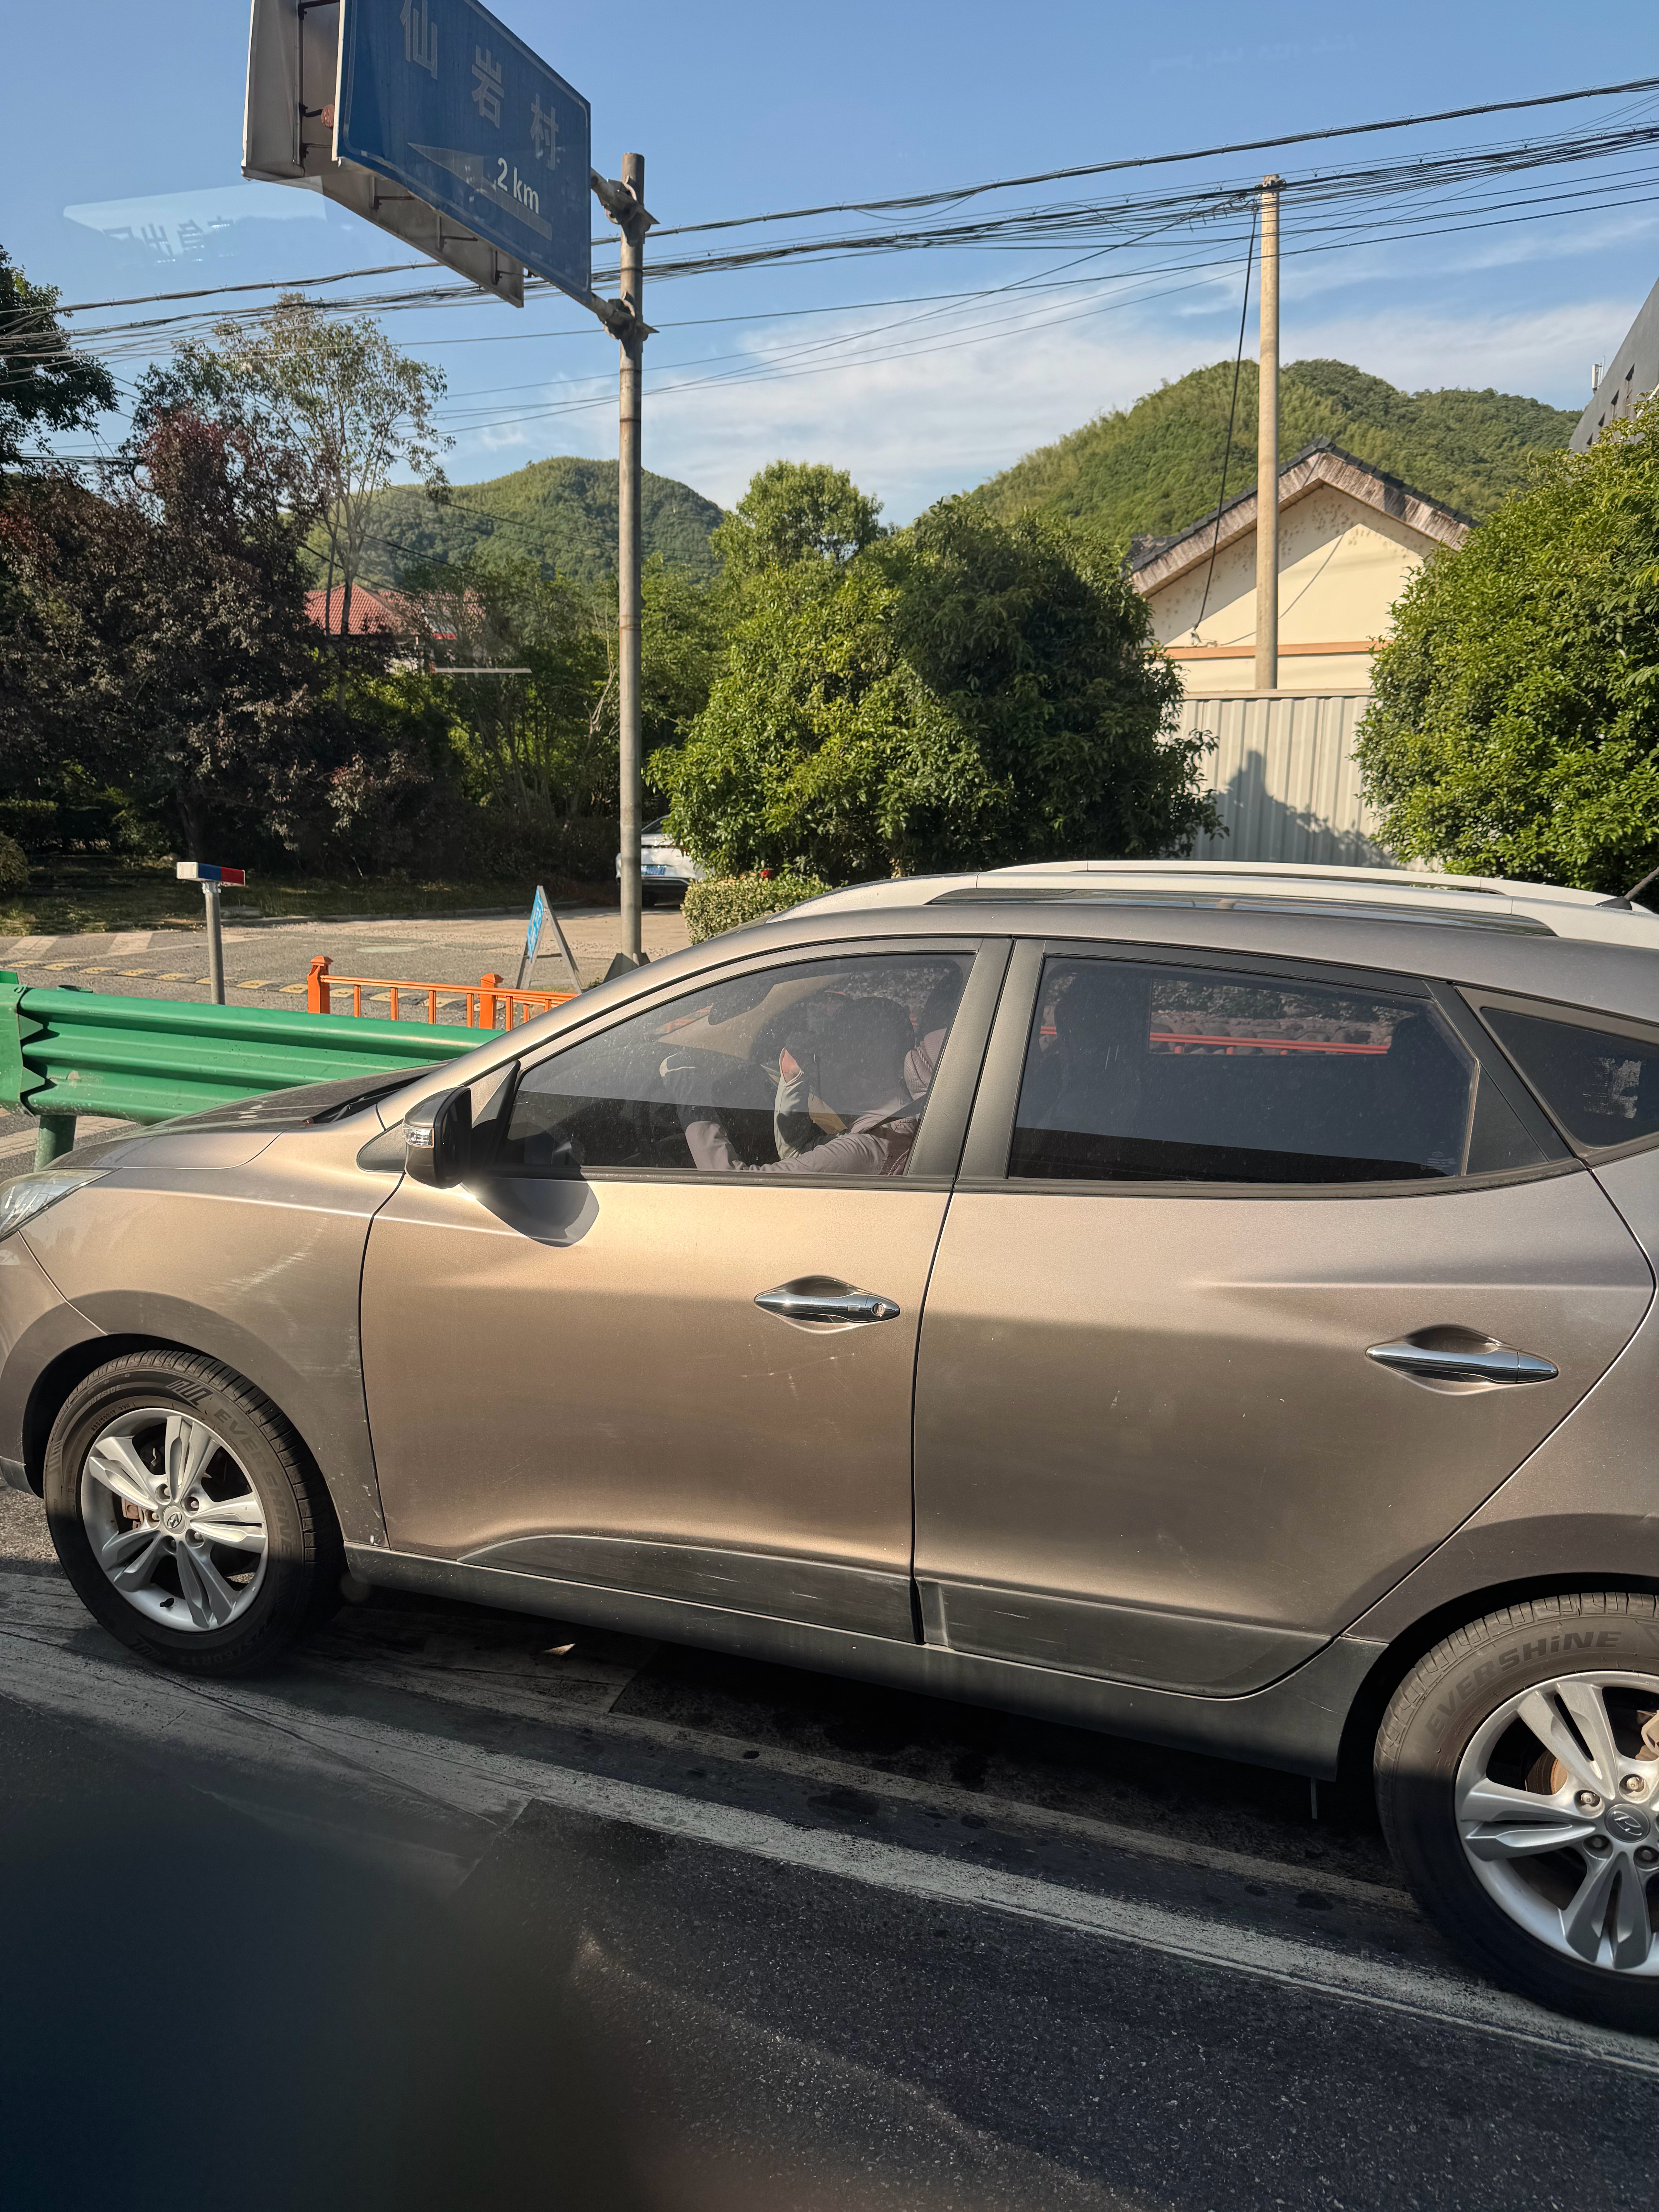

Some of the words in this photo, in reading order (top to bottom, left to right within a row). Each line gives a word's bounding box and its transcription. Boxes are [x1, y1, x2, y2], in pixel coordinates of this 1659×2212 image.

[399, 0, 559, 170] 仙岩村
[497, 157, 508, 191] 2
[513, 167, 539, 214] km
